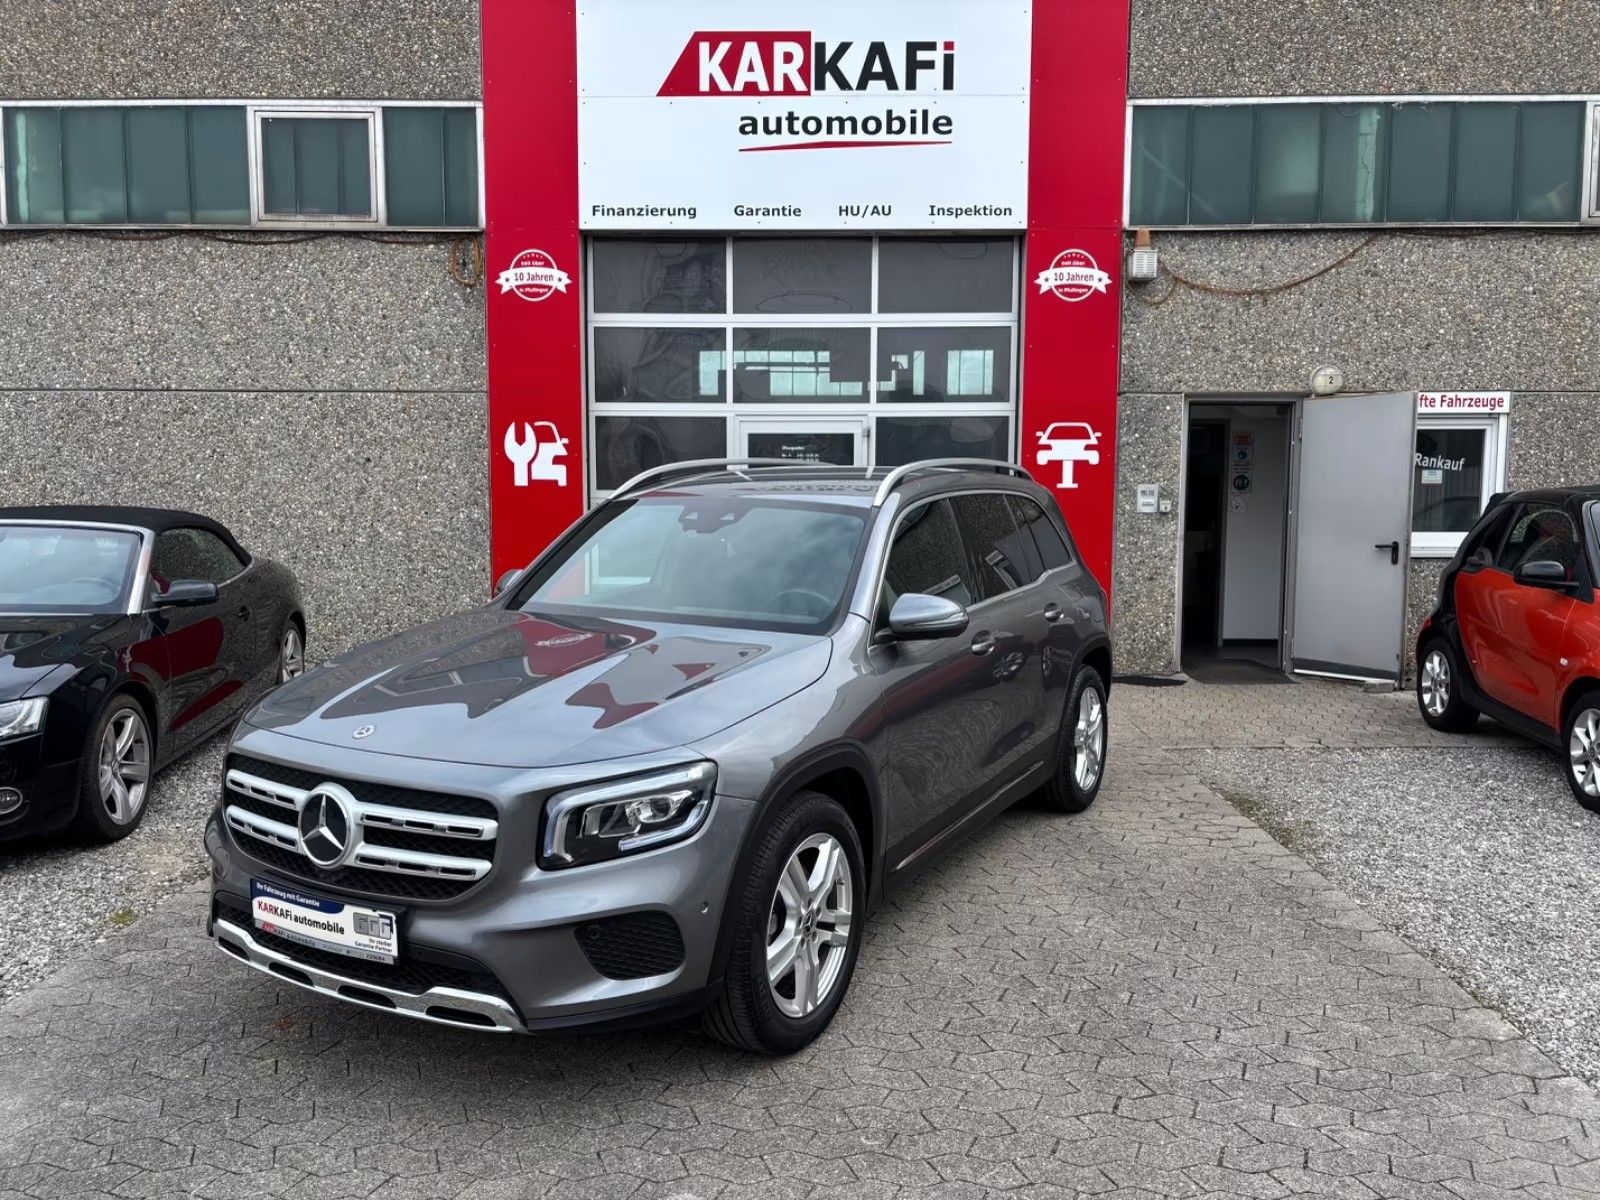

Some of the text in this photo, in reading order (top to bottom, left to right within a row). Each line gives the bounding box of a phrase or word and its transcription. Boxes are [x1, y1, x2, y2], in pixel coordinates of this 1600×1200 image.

[698, 40, 955, 92] KARKAFi
[738, 110, 953, 136] automobile
[592, 204, 1013, 219] Finanzierung Garantie HU/AU Inspektion
[514, 271, 554, 282] 10 Jahren
[1054, 271, 1094, 282] 10 Jahren
[1329, 375, 1334, 384] 2
[1440, 394, 1504, 411] Fahrzeuge
[264, 884, 286, 899] Fahrzeug
[286, 892, 295, 901] mit
[296, 895, 320, 907] Garantie
[258, 900, 293, 921] KARKAFi
[293, 914, 345, 934] automobile
